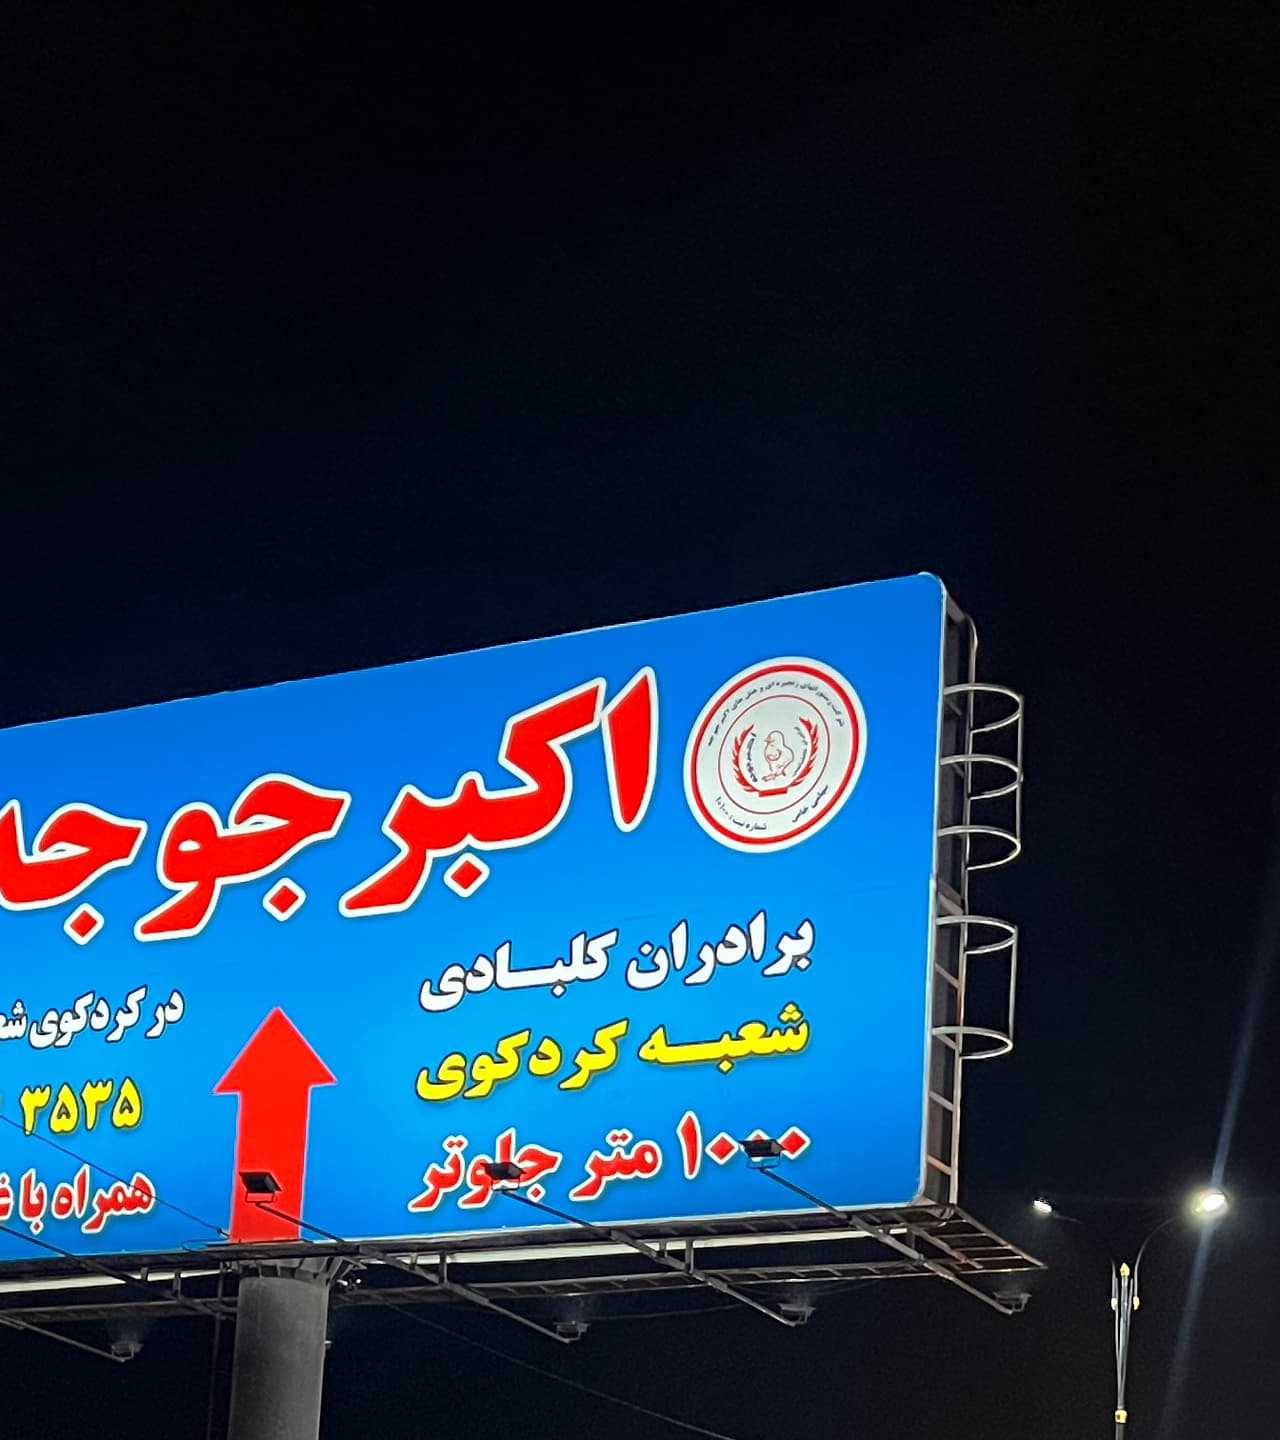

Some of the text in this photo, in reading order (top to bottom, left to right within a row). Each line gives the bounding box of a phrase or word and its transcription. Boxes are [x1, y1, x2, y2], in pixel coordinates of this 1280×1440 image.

[340, 667, 659, 917] اکبر
[419, 910, 814, 1011] برادران کلبادی
[145, 989, 184, 1038] در
[638, 1001, 810, 1074] شعبه
[19, 1076, 143, 1136] ۳۵۳۵
[569, 1129, 662, 1202] متر
[676, 1110, 810, 1180] ۱۰۰
[19, 1168, 47, 1235] با
[53, 1163, 155, 1234] همراه
